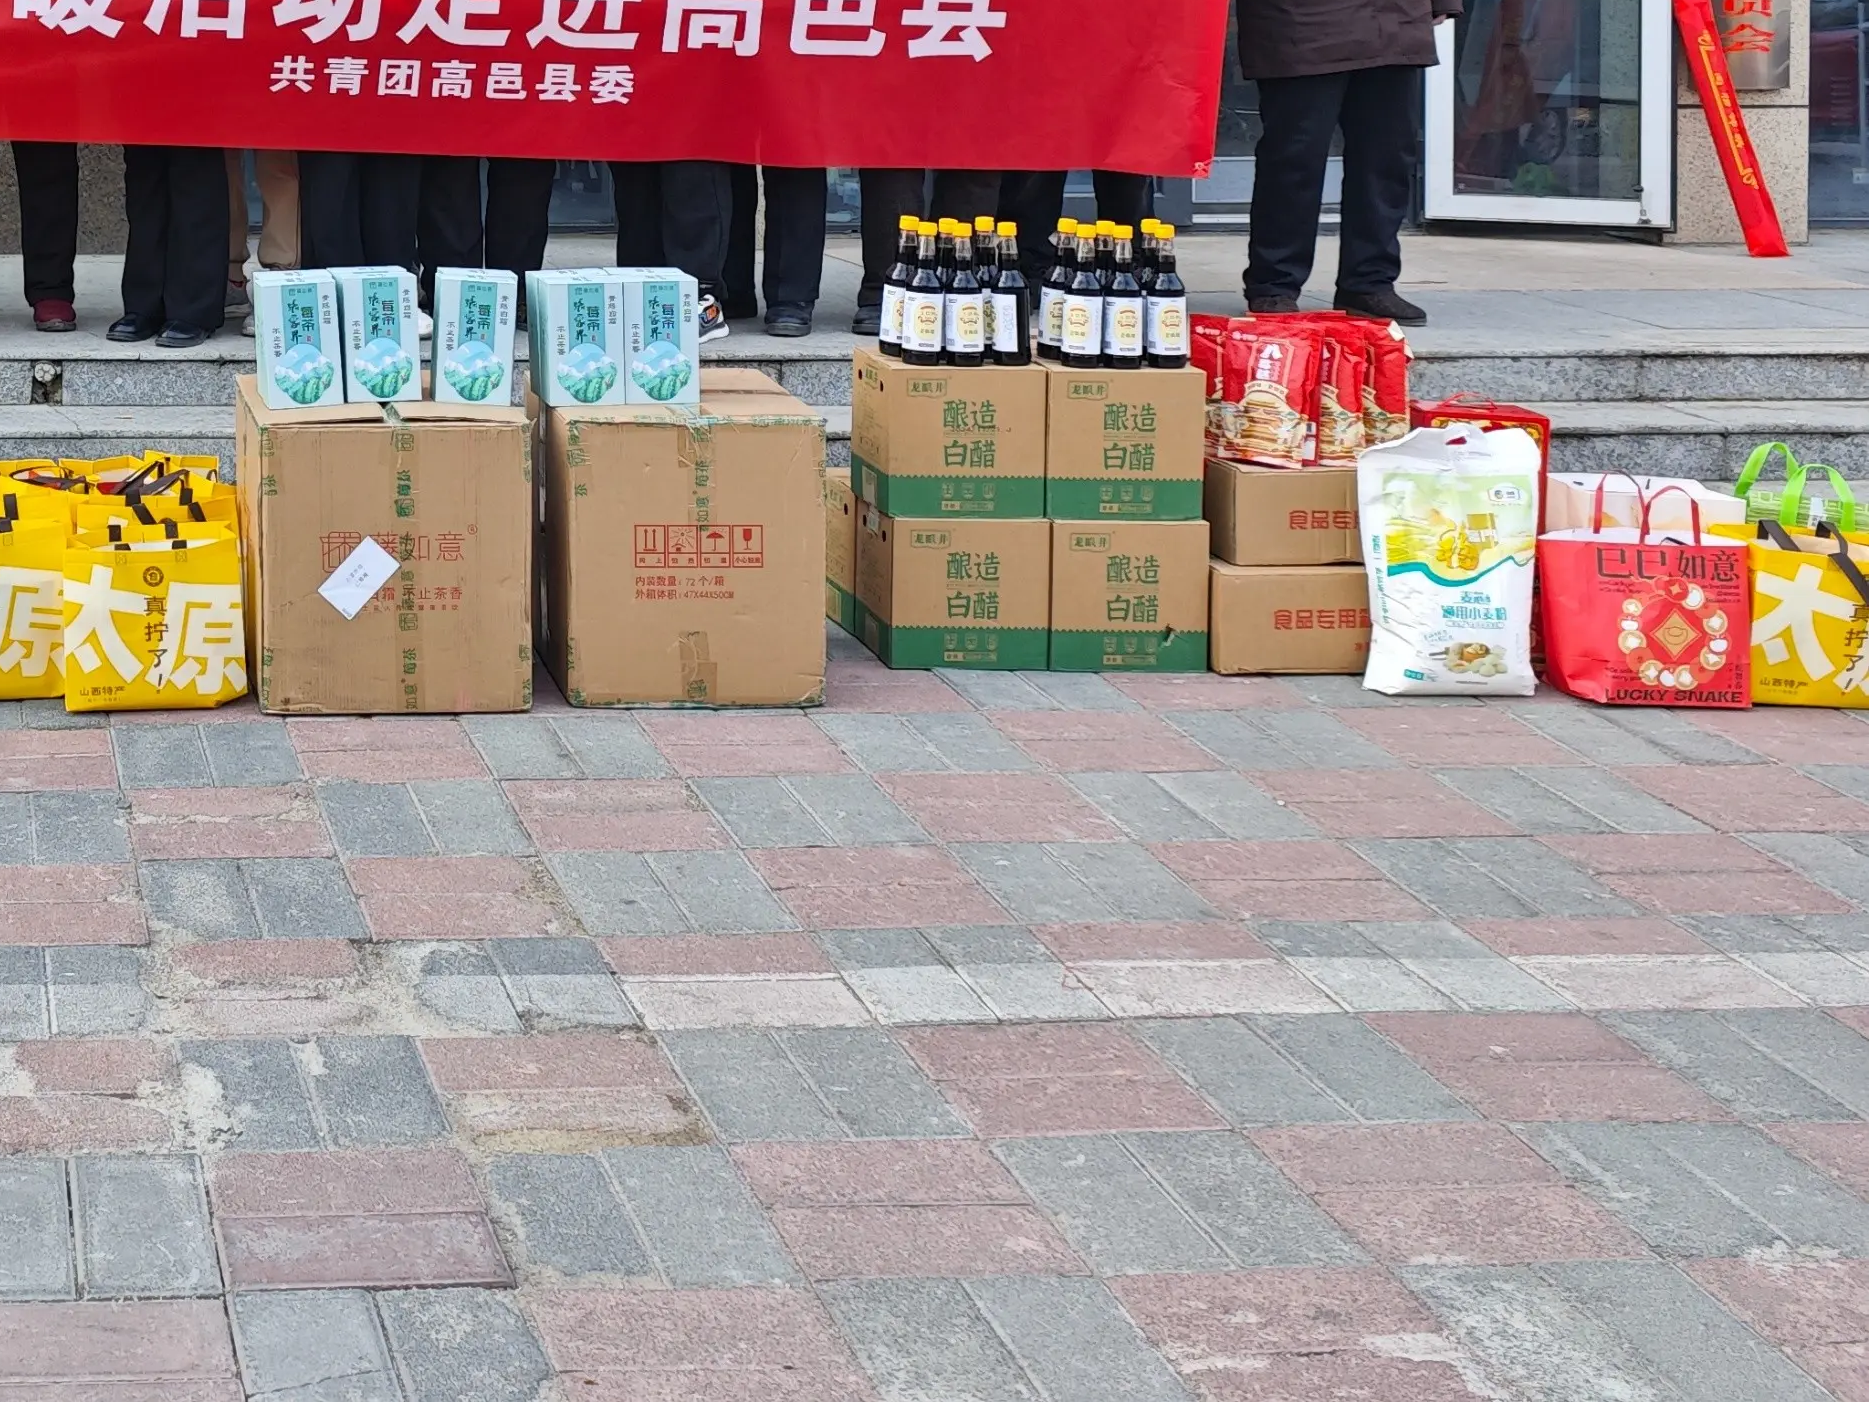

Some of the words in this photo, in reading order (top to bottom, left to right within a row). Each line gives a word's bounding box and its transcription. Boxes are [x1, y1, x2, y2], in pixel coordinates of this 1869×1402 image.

[269, 54, 636, 106] 共青团高邑县委
[943, 399, 997, 429] 酿造
[1103, 402, 1157, 432] 酿造
[944, 439, 996, 468] 白醋
[1103, 442, 1155, 471] 白醋
[1289, 510, 1358, 530] 食品专
[946, 551, 1000, 581] 酿造
[1106, 554, 1160, 584] 酿造
[946, 591, 999, 620] 白醋
[1106, 594, 1159, 623] 白醋
[64, 564, 247, 695] 太原
[79, 685, 126, 698] 山西特产
[1606, 689, 1670, 702] LUCKY
[1674, 690, 1743, 703] SNAKE
[1760, 677, 1809, 690] 山西特产
